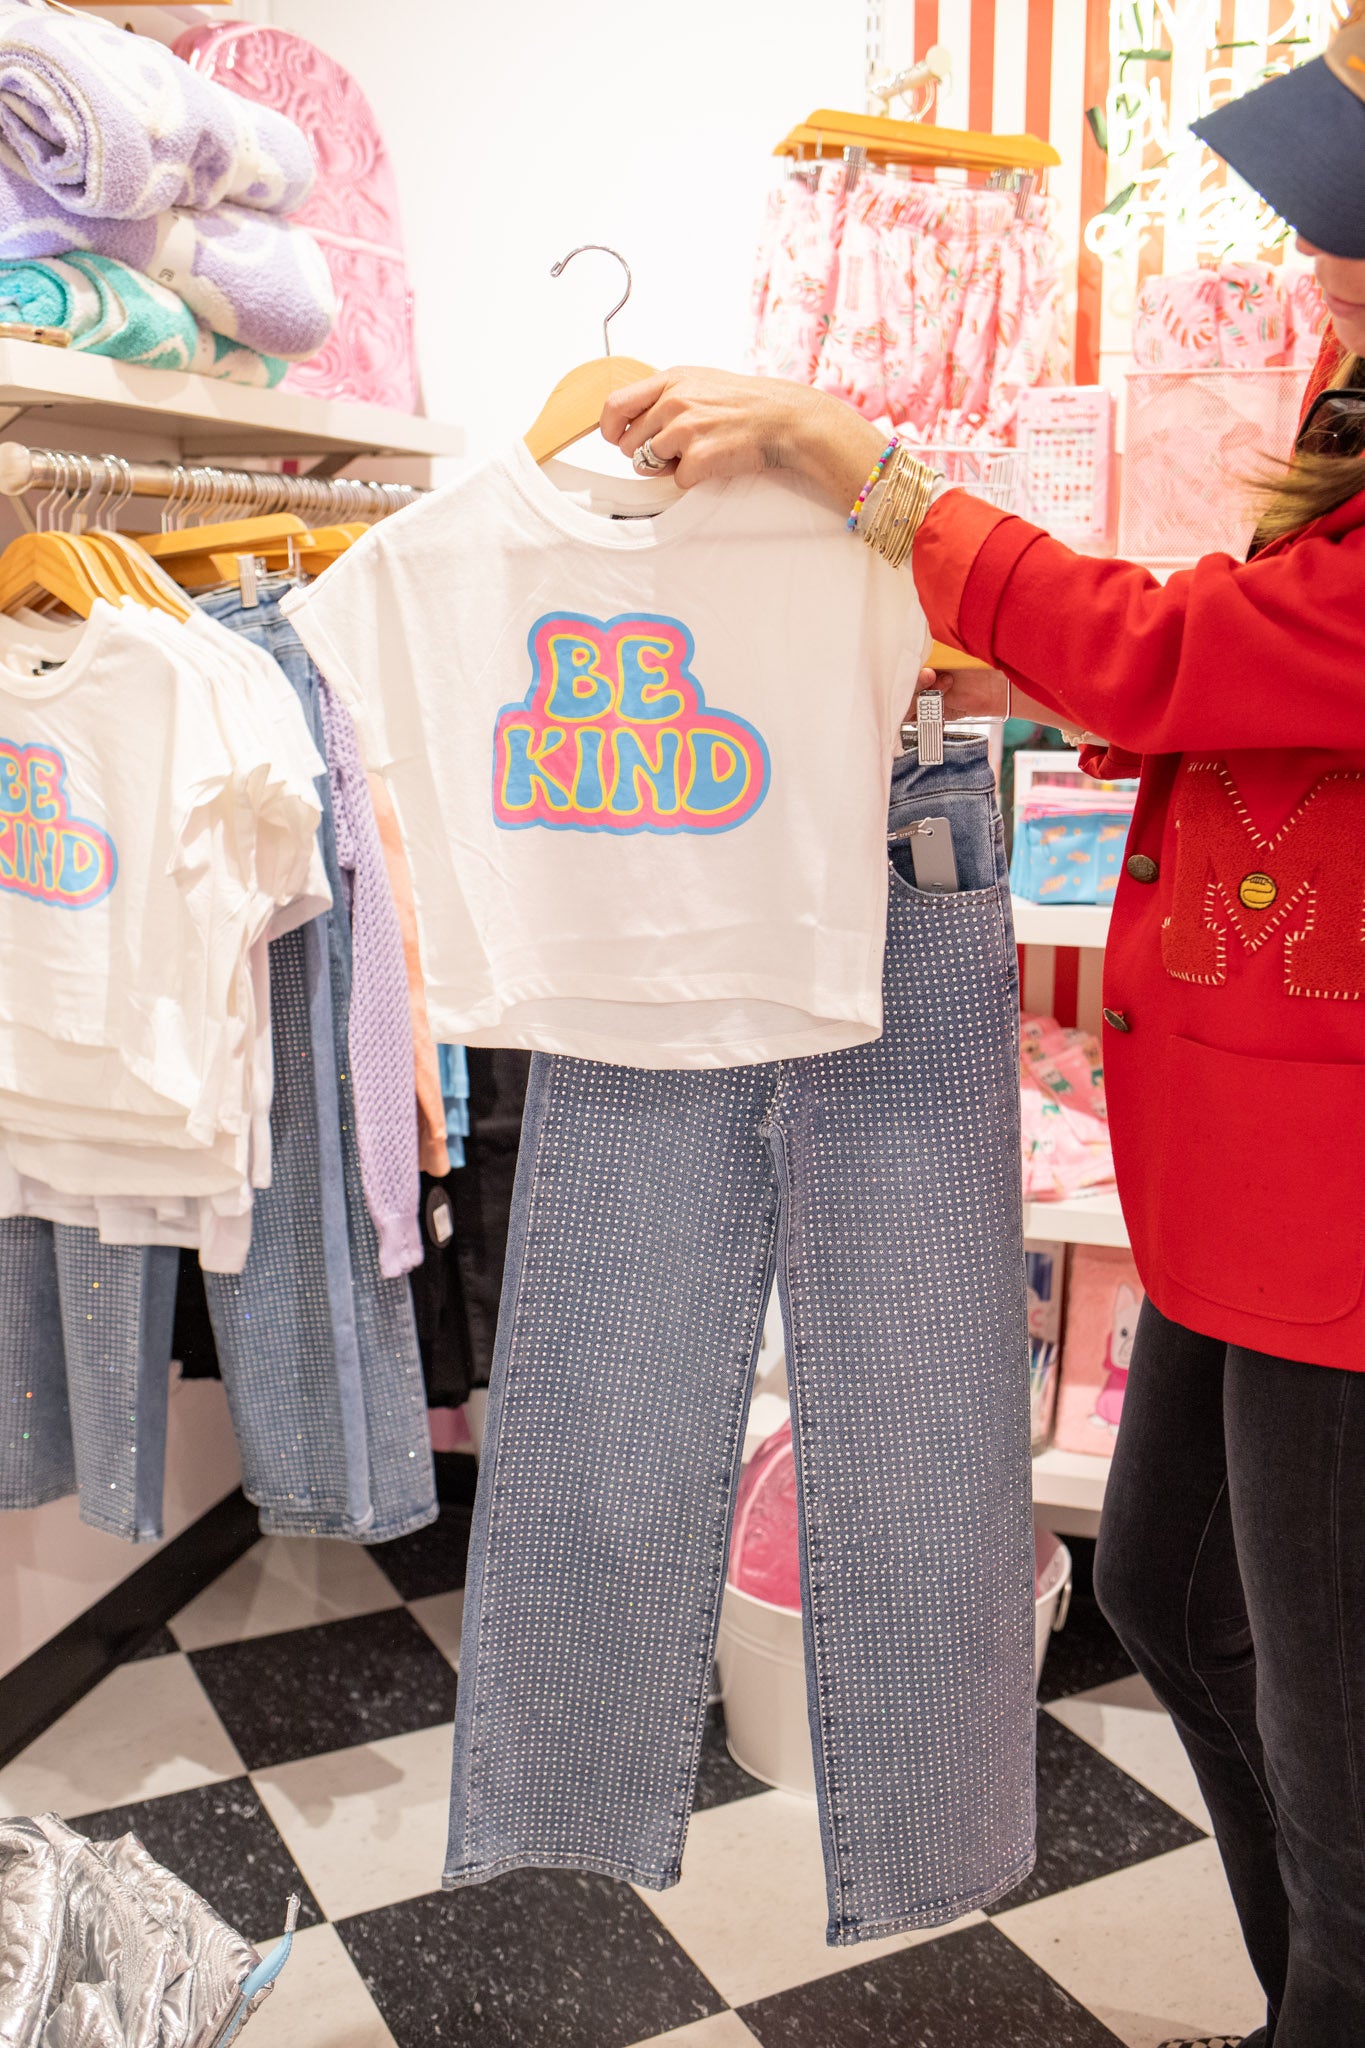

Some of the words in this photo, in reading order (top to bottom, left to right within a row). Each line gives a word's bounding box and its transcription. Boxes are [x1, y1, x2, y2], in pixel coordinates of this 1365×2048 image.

[544, 634, 685, 724] BE
[0, 753, 59, 824] BE
[502, 725, 752, 816] KIND
